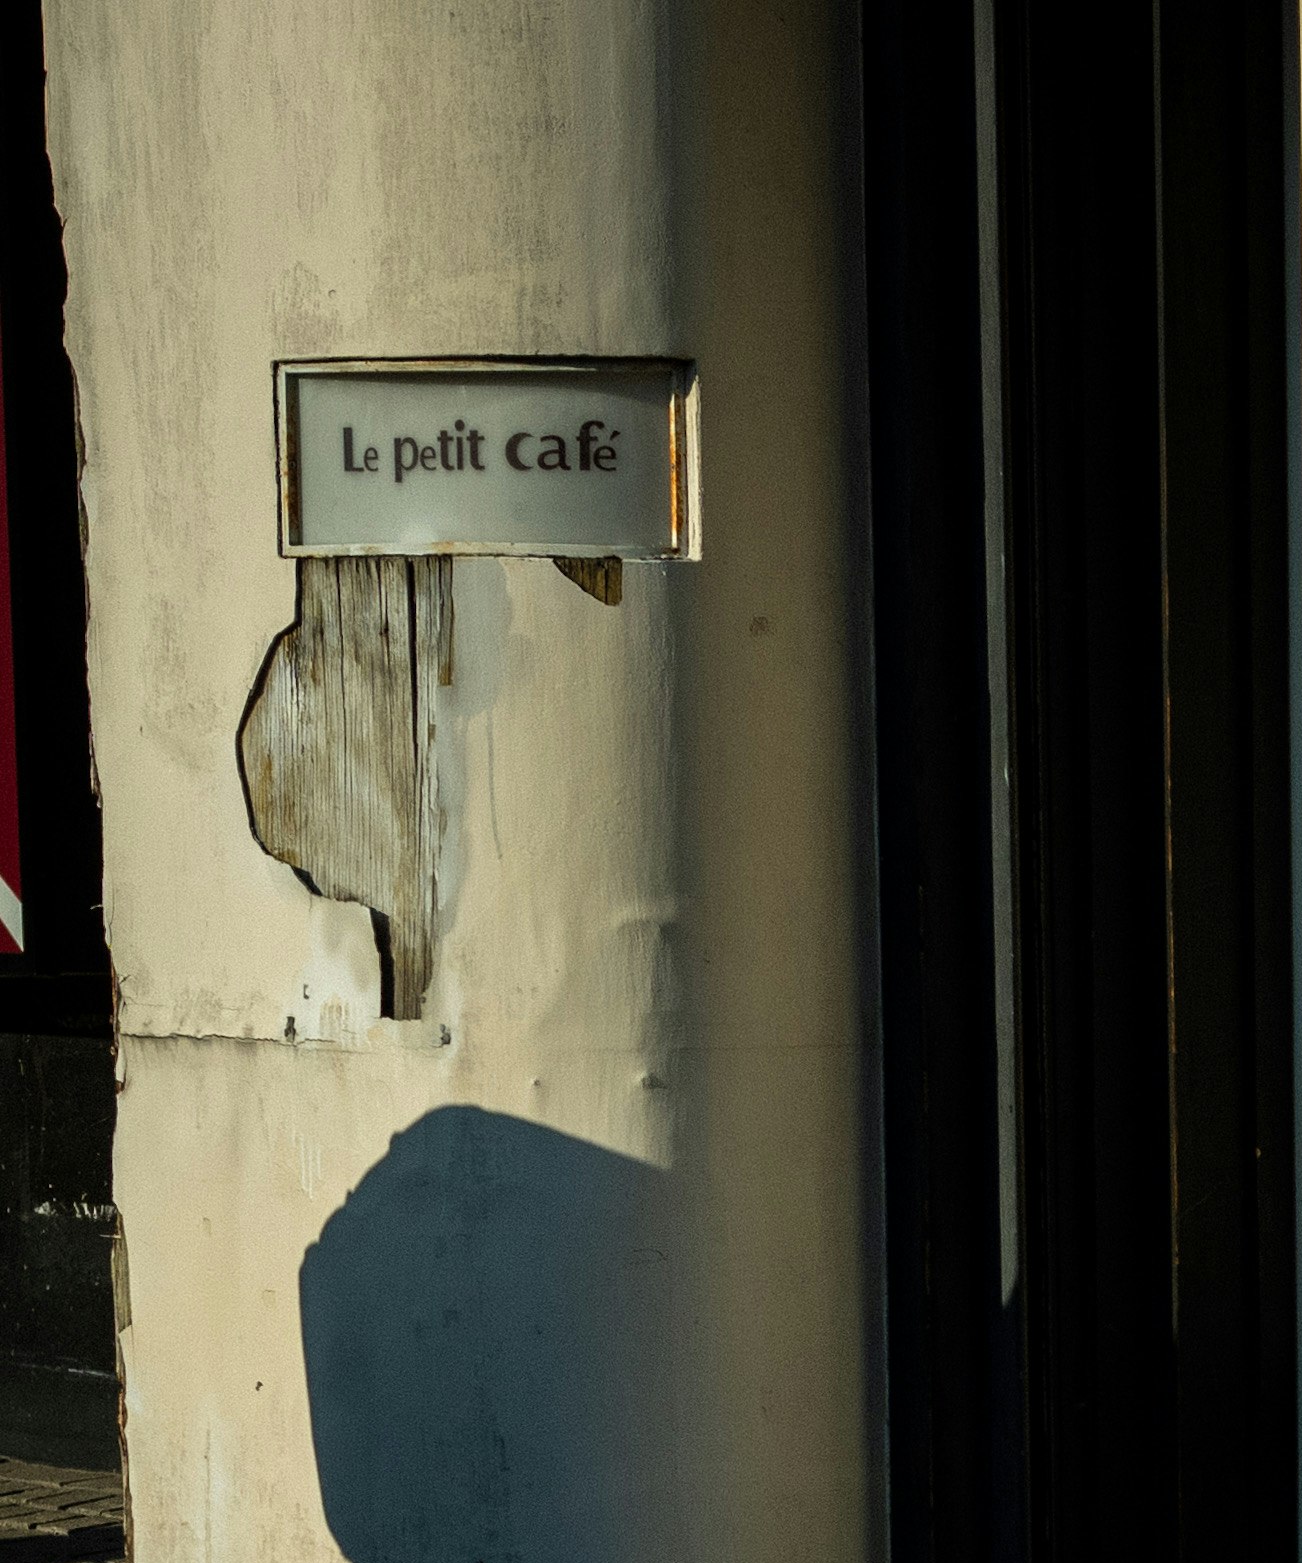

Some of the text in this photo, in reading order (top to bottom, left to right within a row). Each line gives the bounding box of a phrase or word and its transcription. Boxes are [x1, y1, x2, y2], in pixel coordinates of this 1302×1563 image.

[343, 419, 621, 484] Le petit café
